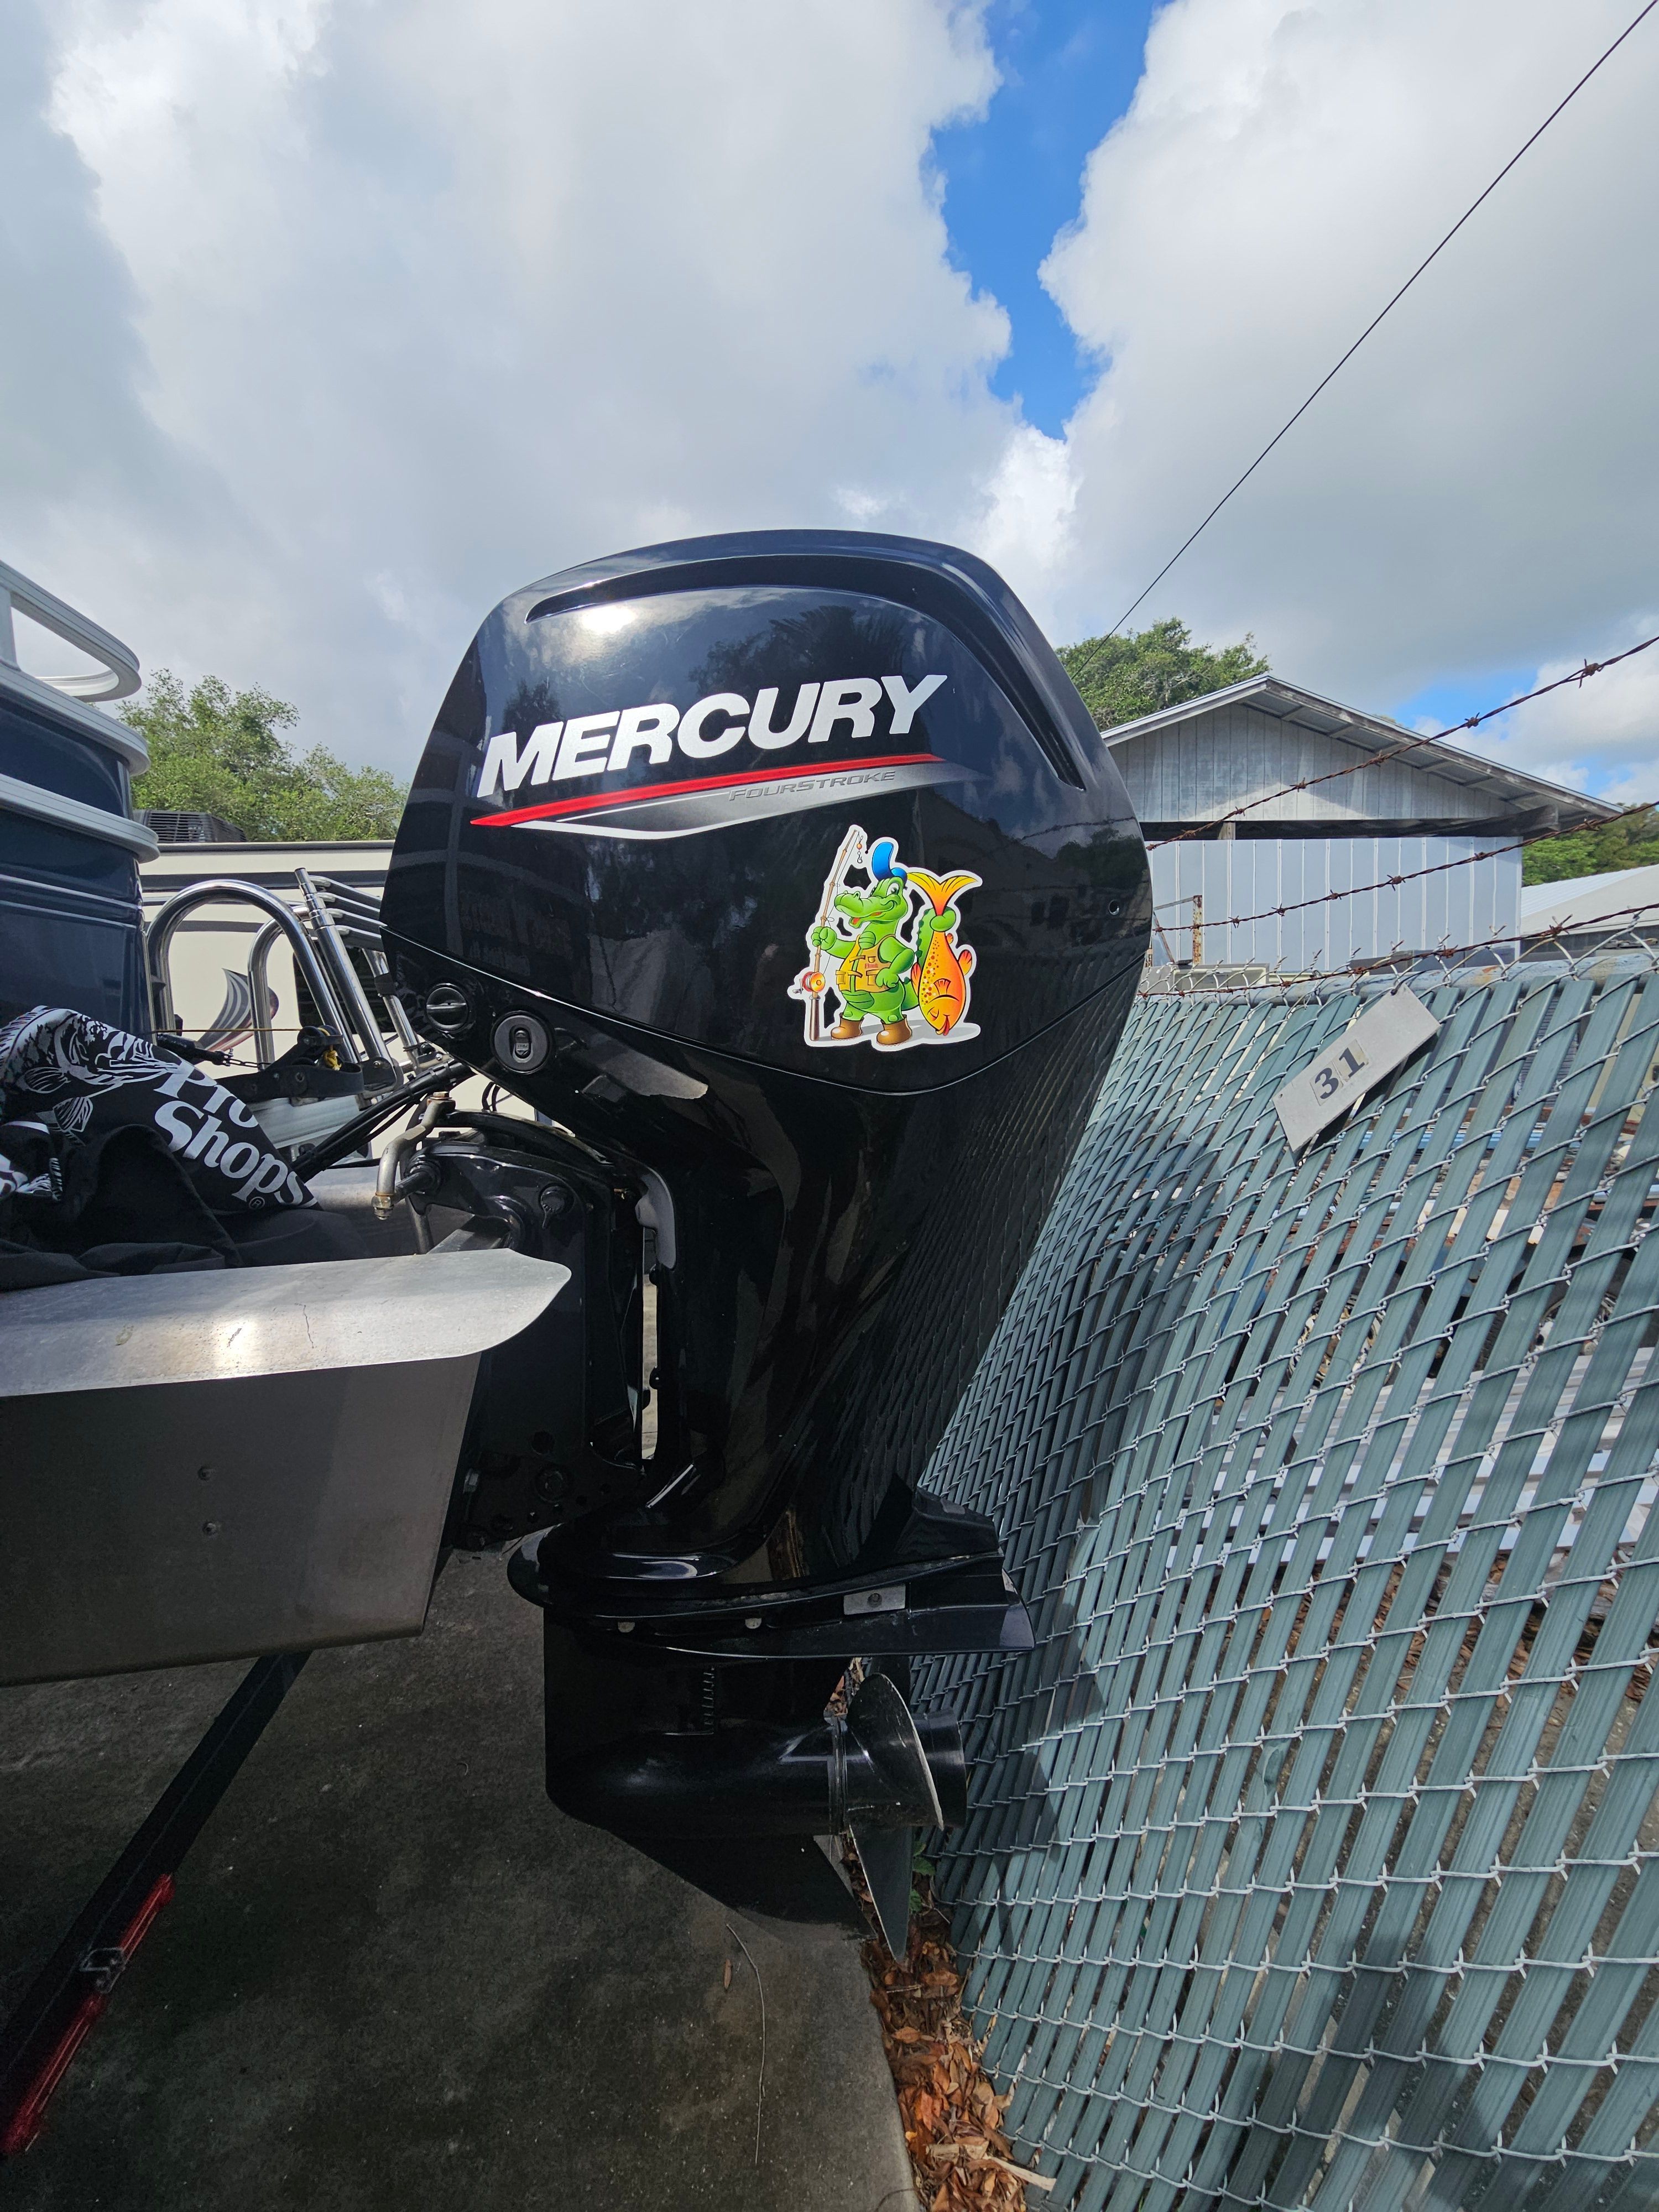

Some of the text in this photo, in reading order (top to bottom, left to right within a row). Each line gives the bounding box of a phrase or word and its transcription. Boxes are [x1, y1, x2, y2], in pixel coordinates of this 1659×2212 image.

[477, 675, 947, 798] MERCURY
[729, 771, 896, 801] FOURSTROKE
[1314, 1047, 1365, 1099] 31
[154, 1100, 318, 1208] Shops
